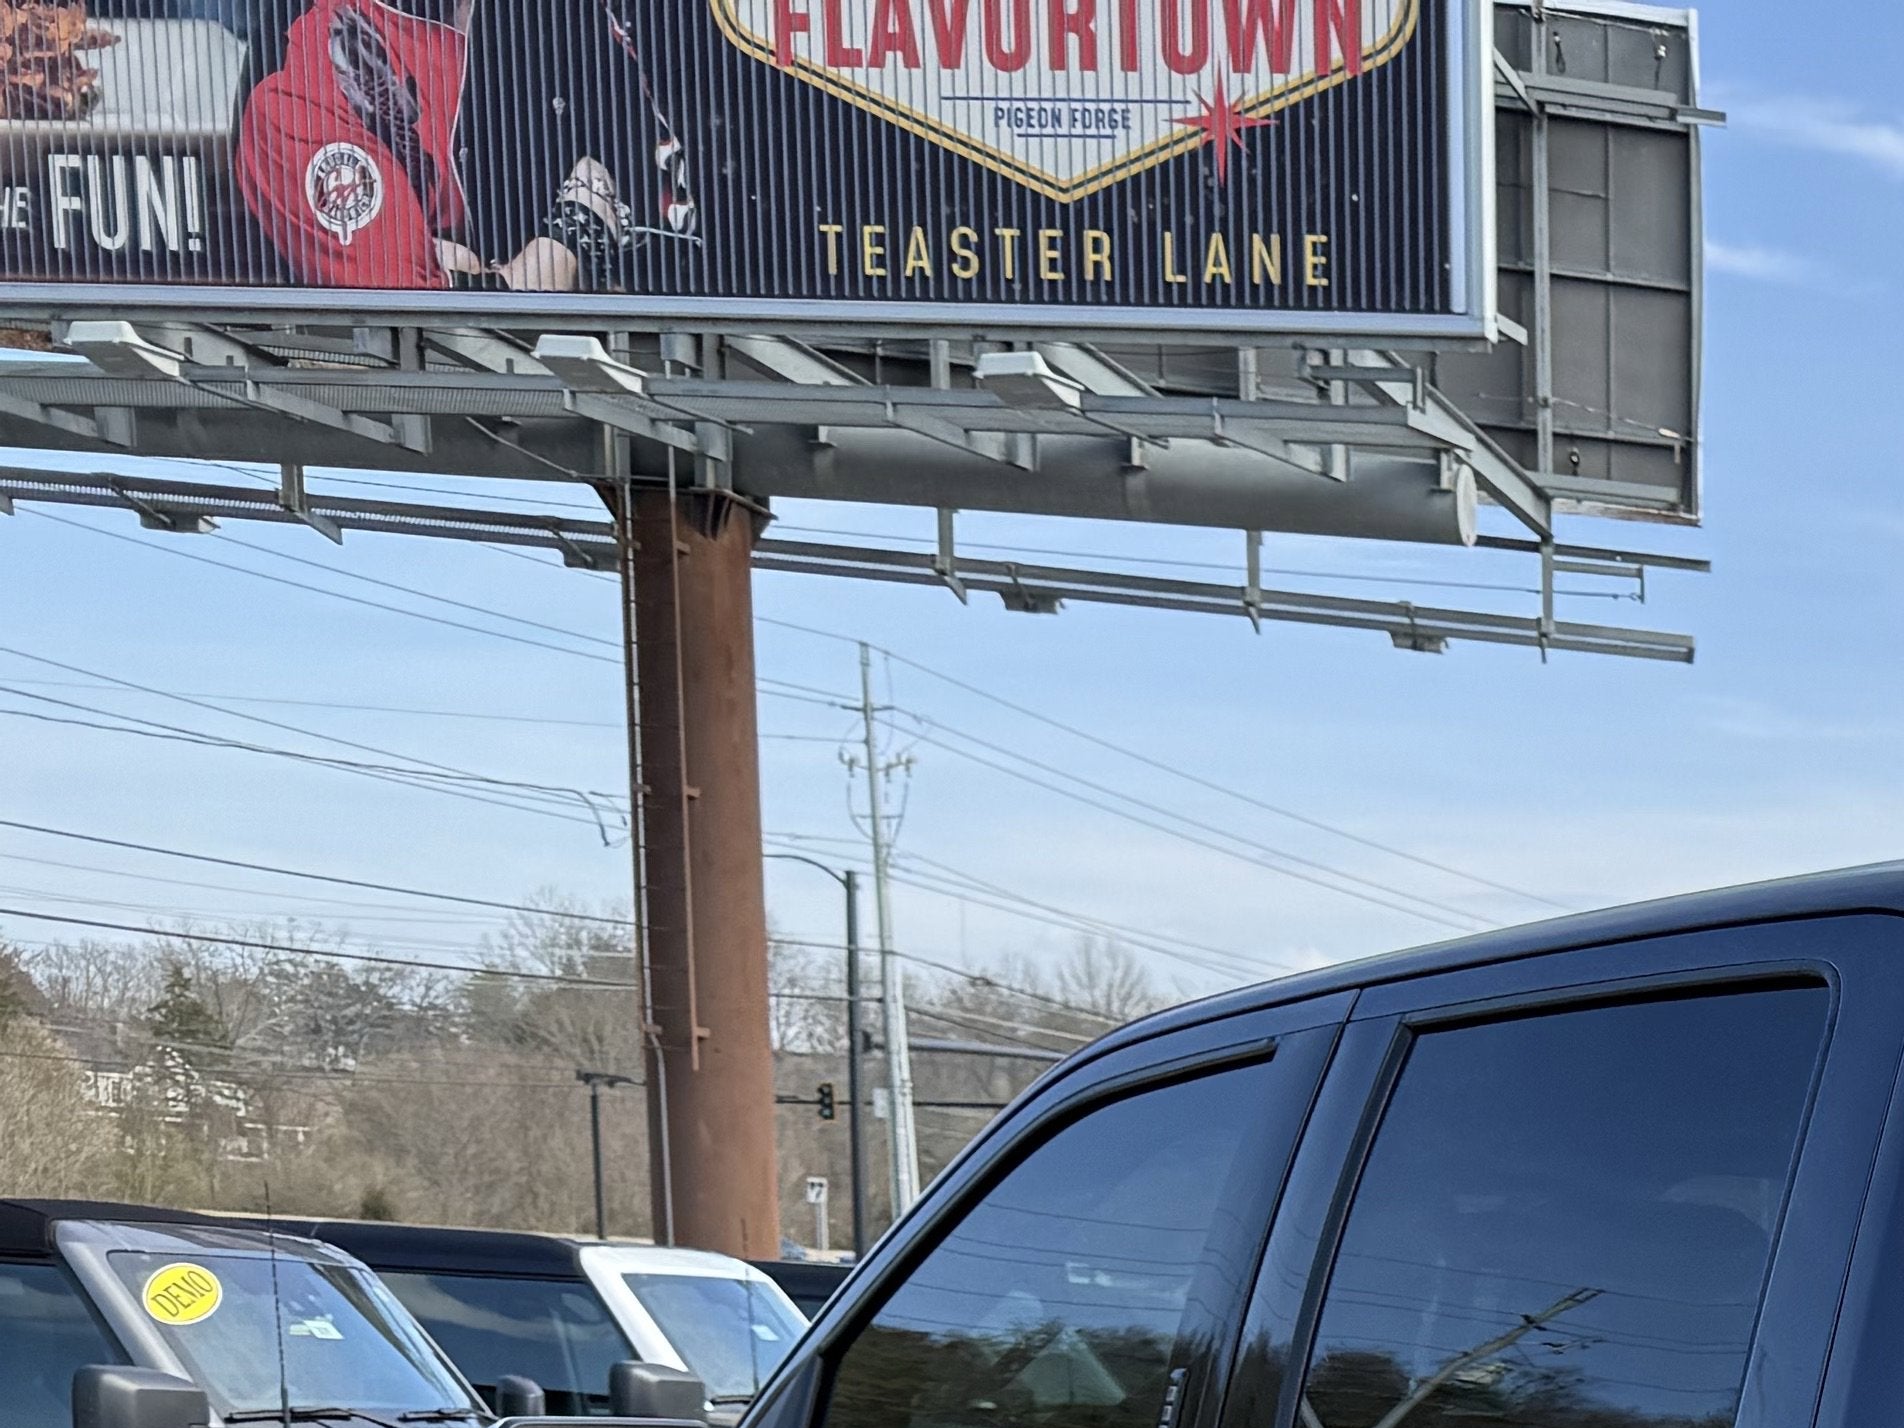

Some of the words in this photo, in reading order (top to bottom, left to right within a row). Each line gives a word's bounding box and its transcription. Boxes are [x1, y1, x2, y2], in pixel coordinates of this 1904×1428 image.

[775, 0, 1362, 76] FLAVORTOWN
[993, 106, 1063, 130] PIGEON
[1070, 107, 1132, 130] FORGE
[47, 153, 202, 252] FUN!
[818, 223, 1112, 283] TEASTER
[1162, 230, 1330, 286] LANE
[150, 1270, 214, 1318] DEMO
